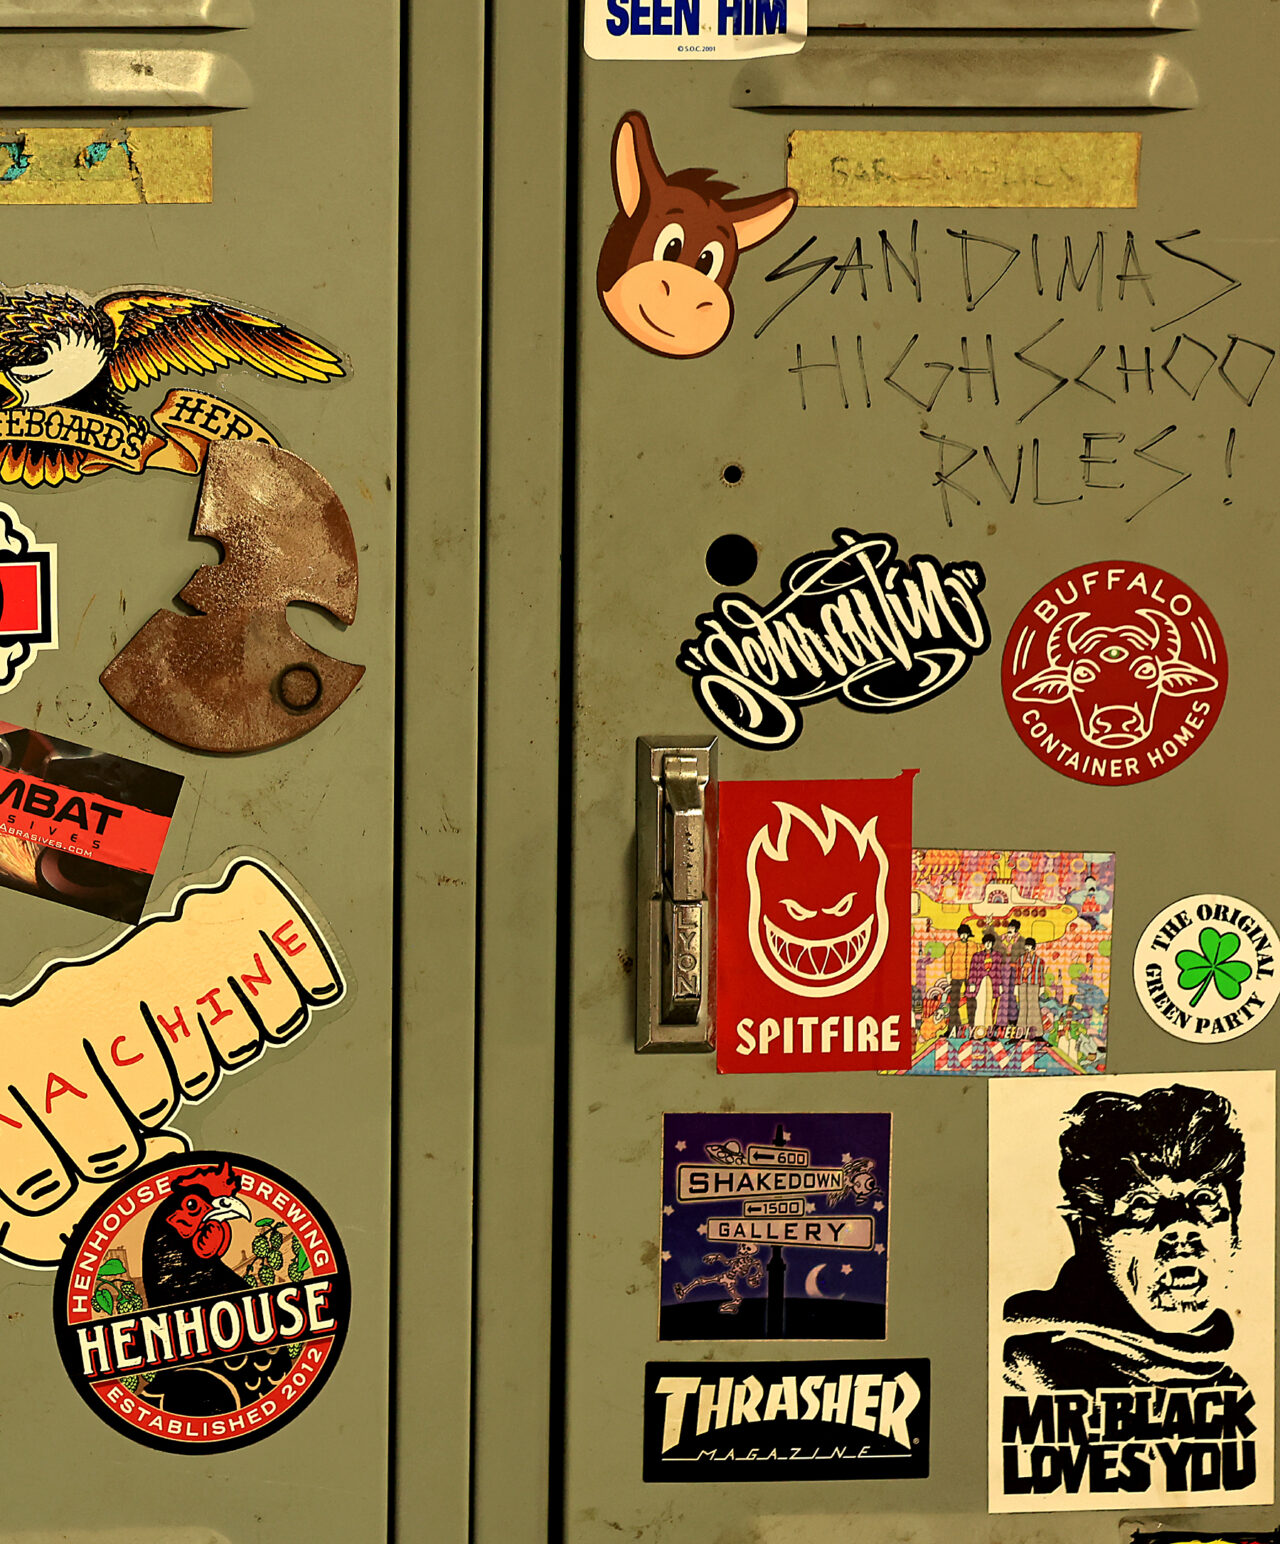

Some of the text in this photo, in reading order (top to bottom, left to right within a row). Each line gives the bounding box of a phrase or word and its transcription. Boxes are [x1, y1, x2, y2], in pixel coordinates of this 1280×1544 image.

[606, 0, 787, 36] SEEN HIM
[753, 218, 1242, 340] SAN DIMAS
[168, 395, 273, 445] HER
[1033, 569, 1192, 624] BUFFALO
[1022, 700, 1211, 777] CONTAINER HOMES
[675, 909, 699, 994] LYON
[1150, 904, 1274, 981] THE ORIGINAL
[1145, 963, 1266, 1035] GREEN PARTY
[736, 1014, 901, 1056] SPITFIRE
[688, 1172, 842, 1194] SHAKEDOWN
[777, 1152, 805, 1165] 600
[719, 1222, 846, 1242] GALLERY
[763, 1201, 800, 1214] 1500
[72, 1173, 330, 1313] HENHOUSE BREWING
[76, 1281, 337, 1377] HENHOUSE
[106, 1347, 323, 1437] ESTABLISHED 2012
[655, 1371, 921, 1455] THRASHER
[696, 1446, 871, 1461] MAGAZINE
[1002, 1440, 1257, 1495] LOVES YOU
